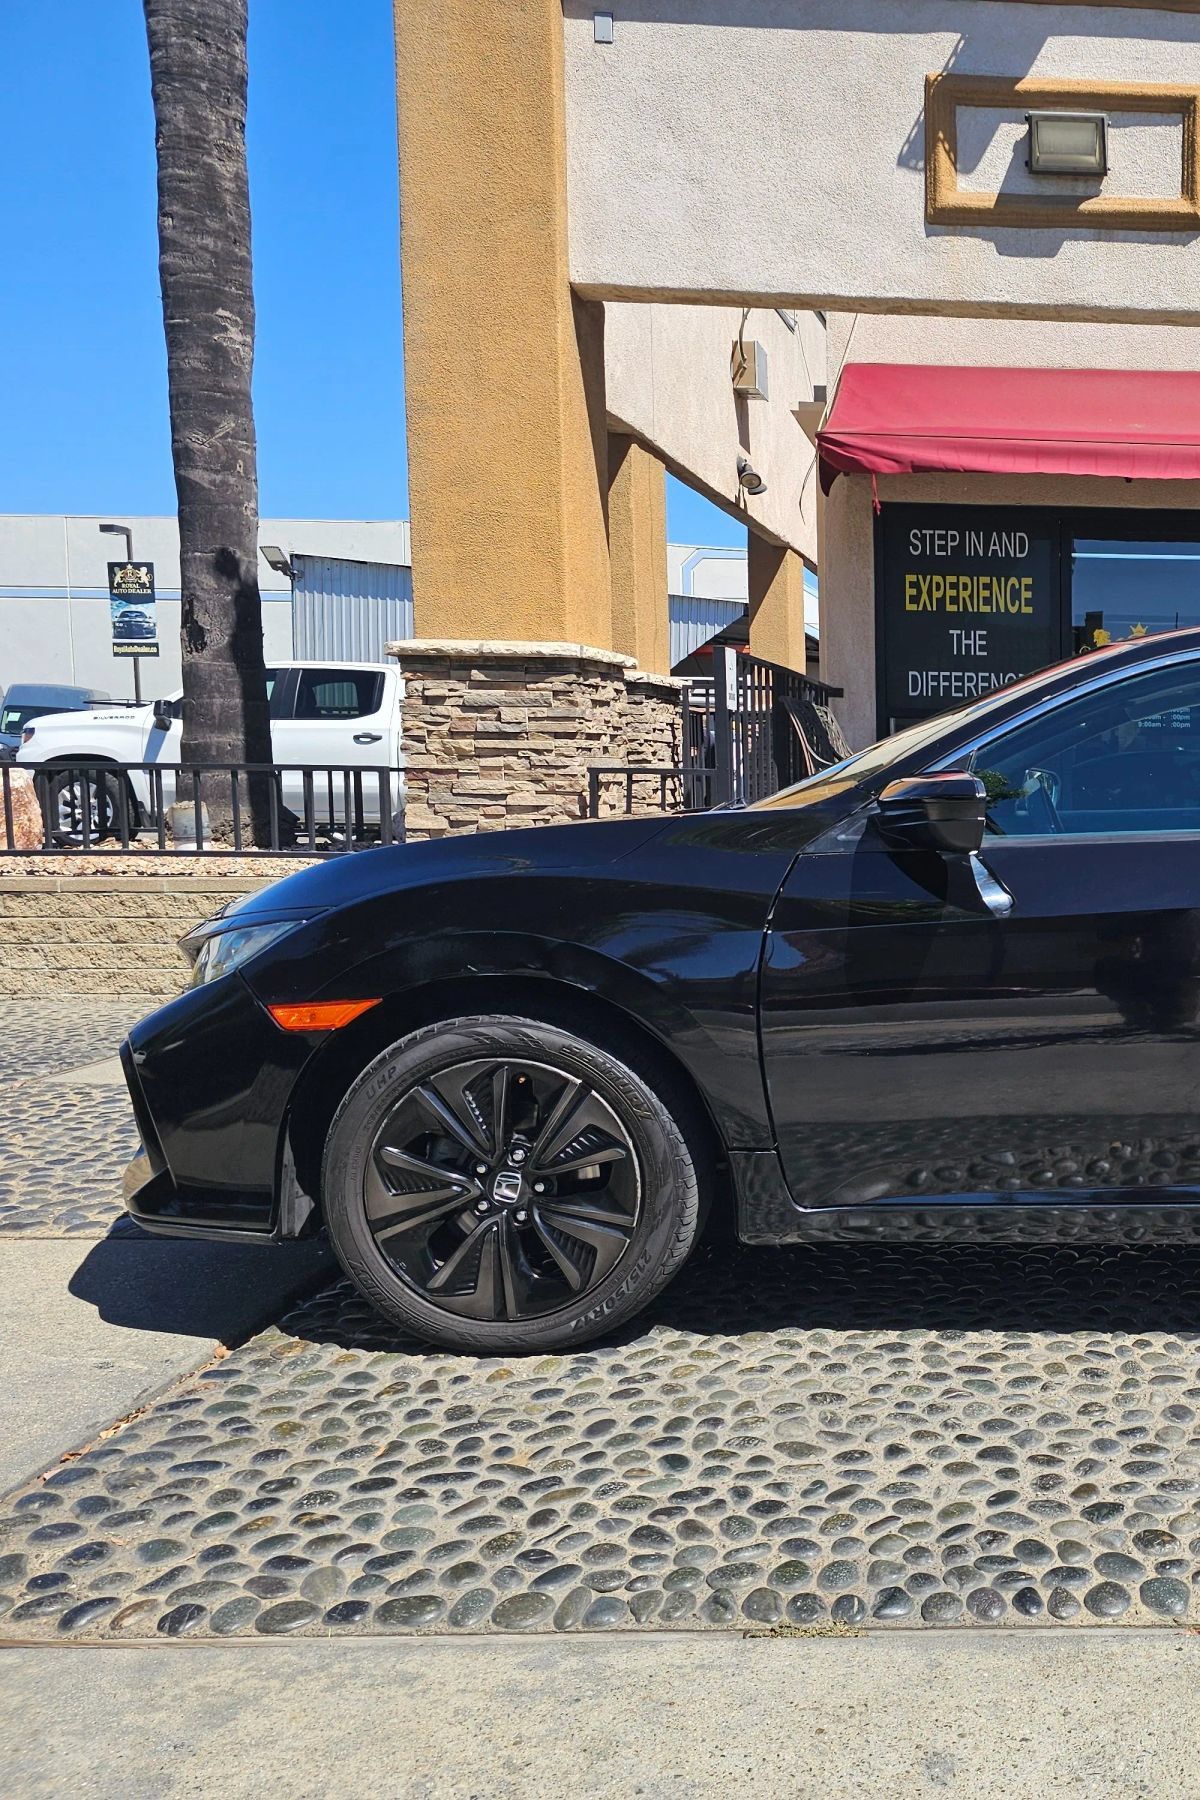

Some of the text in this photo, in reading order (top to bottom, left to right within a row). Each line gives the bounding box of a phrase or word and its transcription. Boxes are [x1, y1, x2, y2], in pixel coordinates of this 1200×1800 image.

[909, 529, 1029, 558] STEP IN AND
[905, 574, 1034, 614] EXPERIENCE
[949, 630, 987, 656] THE
[908, 670, 1024, 698] DIFFEREN
[365, 1064, 398, 1101] UHP
